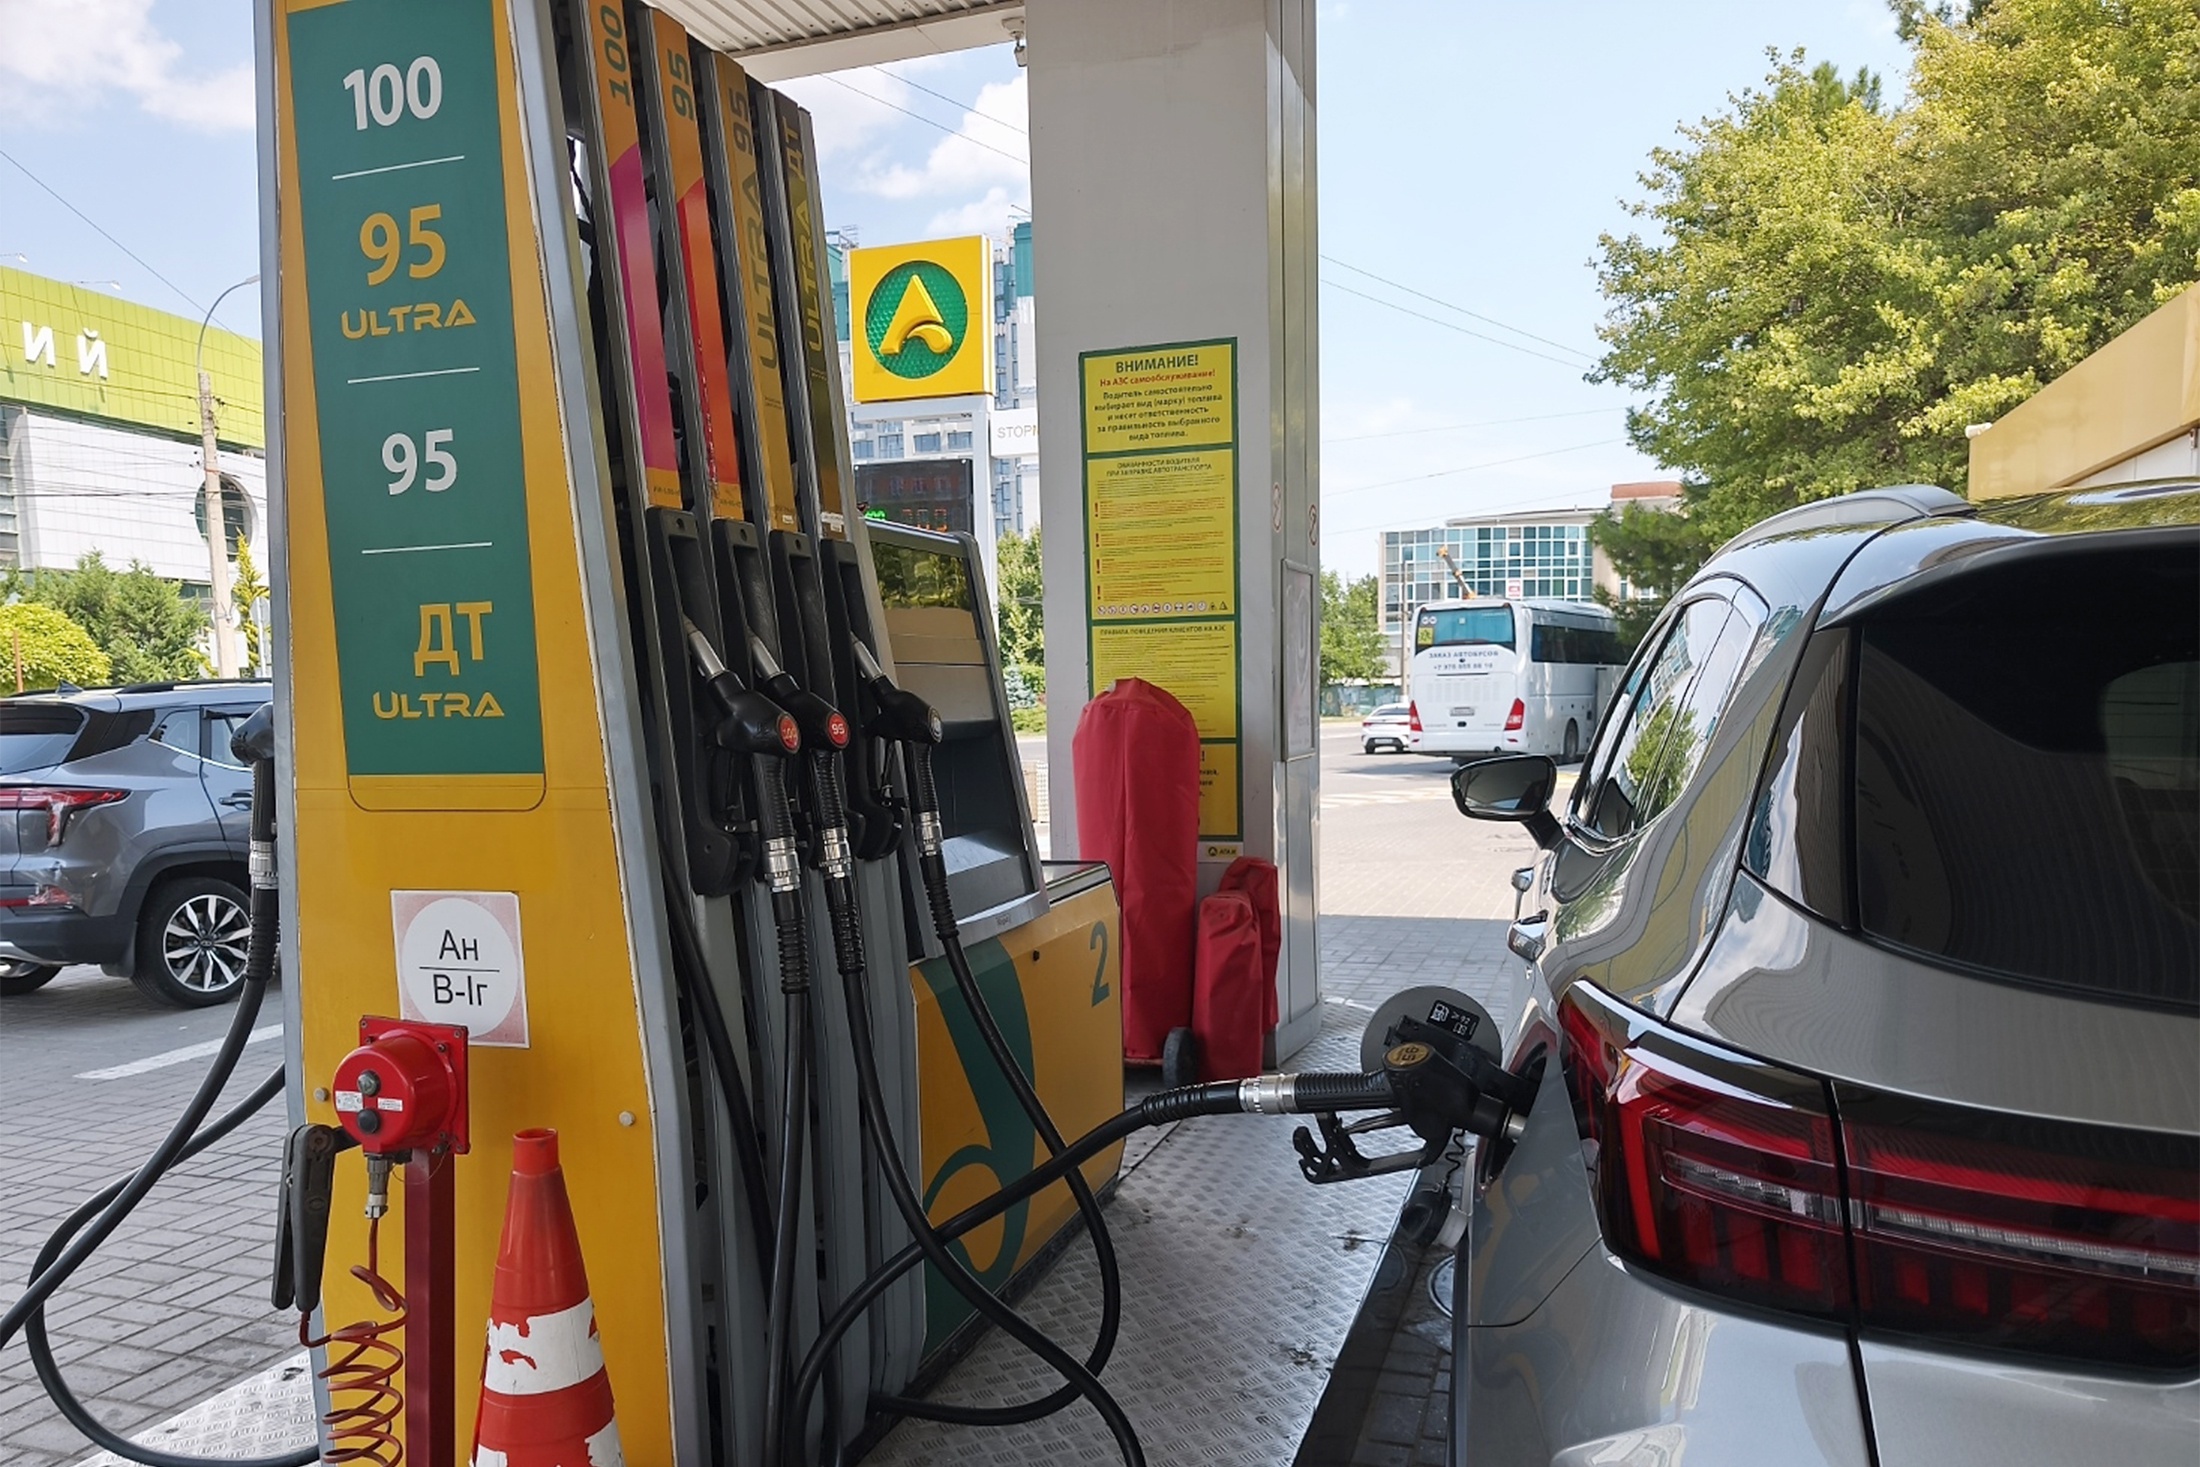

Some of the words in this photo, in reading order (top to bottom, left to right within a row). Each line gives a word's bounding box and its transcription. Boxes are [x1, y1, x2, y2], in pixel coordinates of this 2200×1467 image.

[600, 5, 631, 107] 100
[342, 56, 443, 130] 100
[667, 48, 694, 121] 95
[728, 87, 754, 156] 95
[359, 203, 447, 286] 95
[742, 171, 778, 369] ULTRA
[796, 200, 823, 352] ULTRA
[340, 299, 478, 340] ULTRA
[1100, 378, 1111, 387] На
[1113, 376, 1129, 386] АЗС
[1130, 369, 1216, 384] самообслуживание!
[1115, 354, 1199, 373] ВНИМАНИЕ!
[1094, 402, 1135, 412] выбирает
[1136, 400, 1153, 408] вид
[1154, 396, 1186, 408] (марку)
[1187, 394, 1223, 403] топлива
[1103, 390, 1143, 400] Водитель
[1144, 384, 1213, 396] самостоятельно
[1097, 425, 1106, 433] за
[1107, 420, 1166, 433] правильность
[1168, 416, 1221, 427] выбранного
[1138, 406, 1209, 419] ответственность
[1128, 432, 1149, 442] вида
[381, 428, 458, 496] 95
[413, 601, 493, 677] ДТ
[1428, 651, 1452, 659] ЗАКАЗ
[1453, 650, 1499, 659] АВТОБУСОВ
[372, 692, 505, 721] ULTRA
[831, 723, 846, 735] 95
[438, 929, 480, 961] Ан
[1089, 920, 1111, 1008] 2
